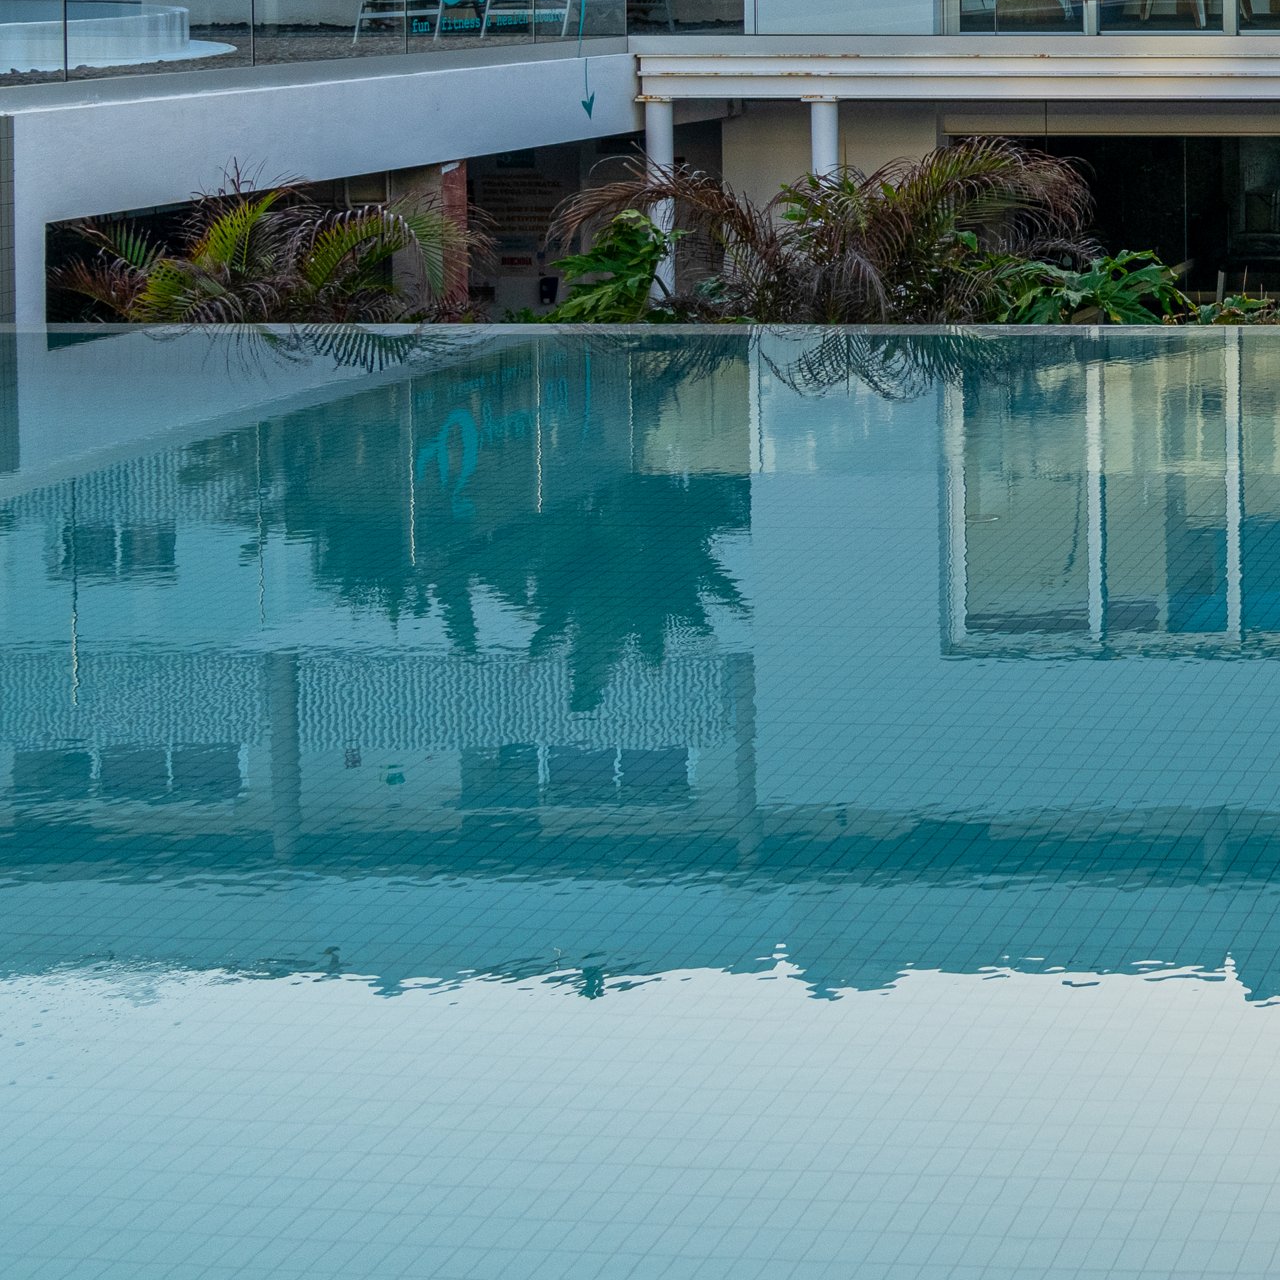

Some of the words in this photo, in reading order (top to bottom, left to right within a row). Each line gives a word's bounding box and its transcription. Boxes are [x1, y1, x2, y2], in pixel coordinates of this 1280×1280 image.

[412, 19, 430, 33] fun
[441, 17, 481, 31] fitness
[496, 10, 528, 26] health
